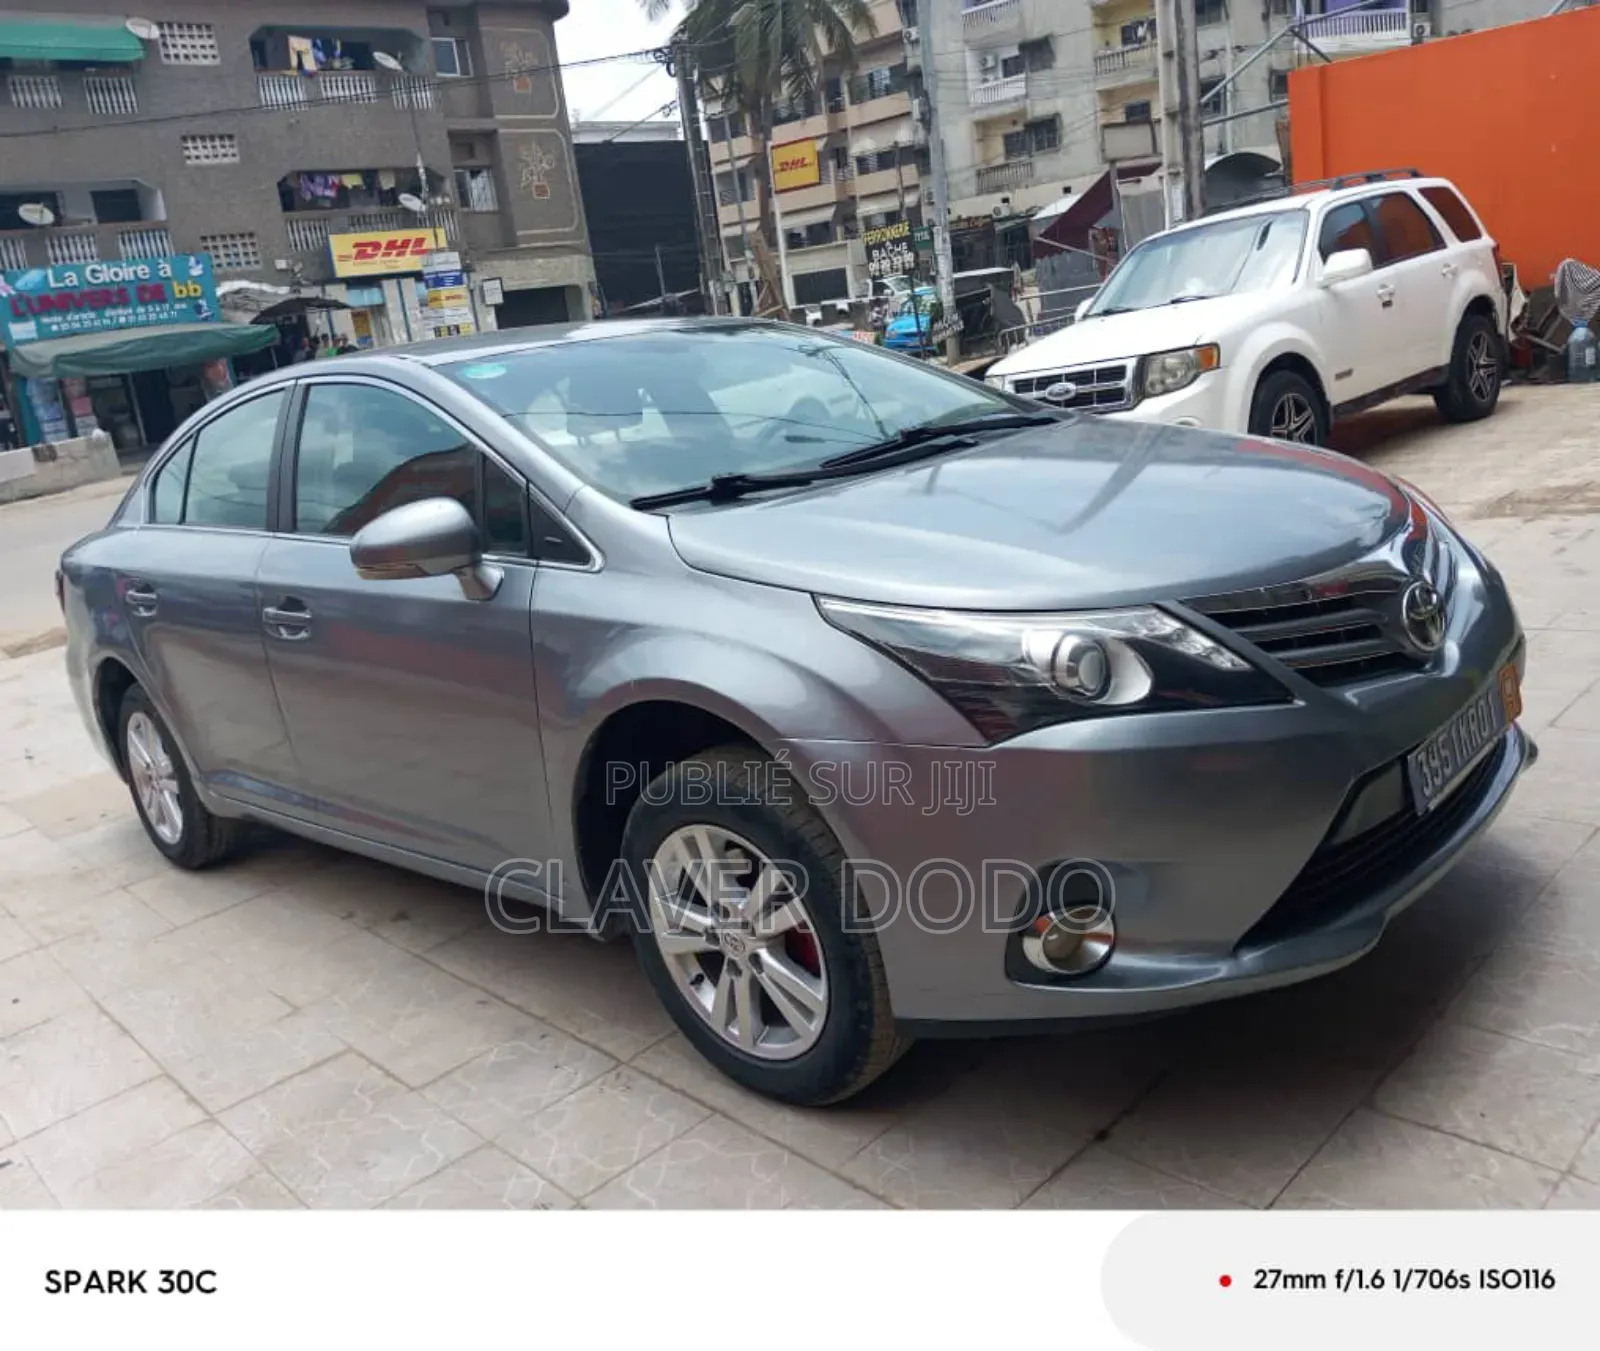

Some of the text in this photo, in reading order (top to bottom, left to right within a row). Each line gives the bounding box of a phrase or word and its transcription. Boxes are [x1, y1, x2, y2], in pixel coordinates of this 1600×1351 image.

[353, 237, 430, 261] DHL
[48, 260, 172, 288] La Gloire à
[173, 280, 202, 299] bb
